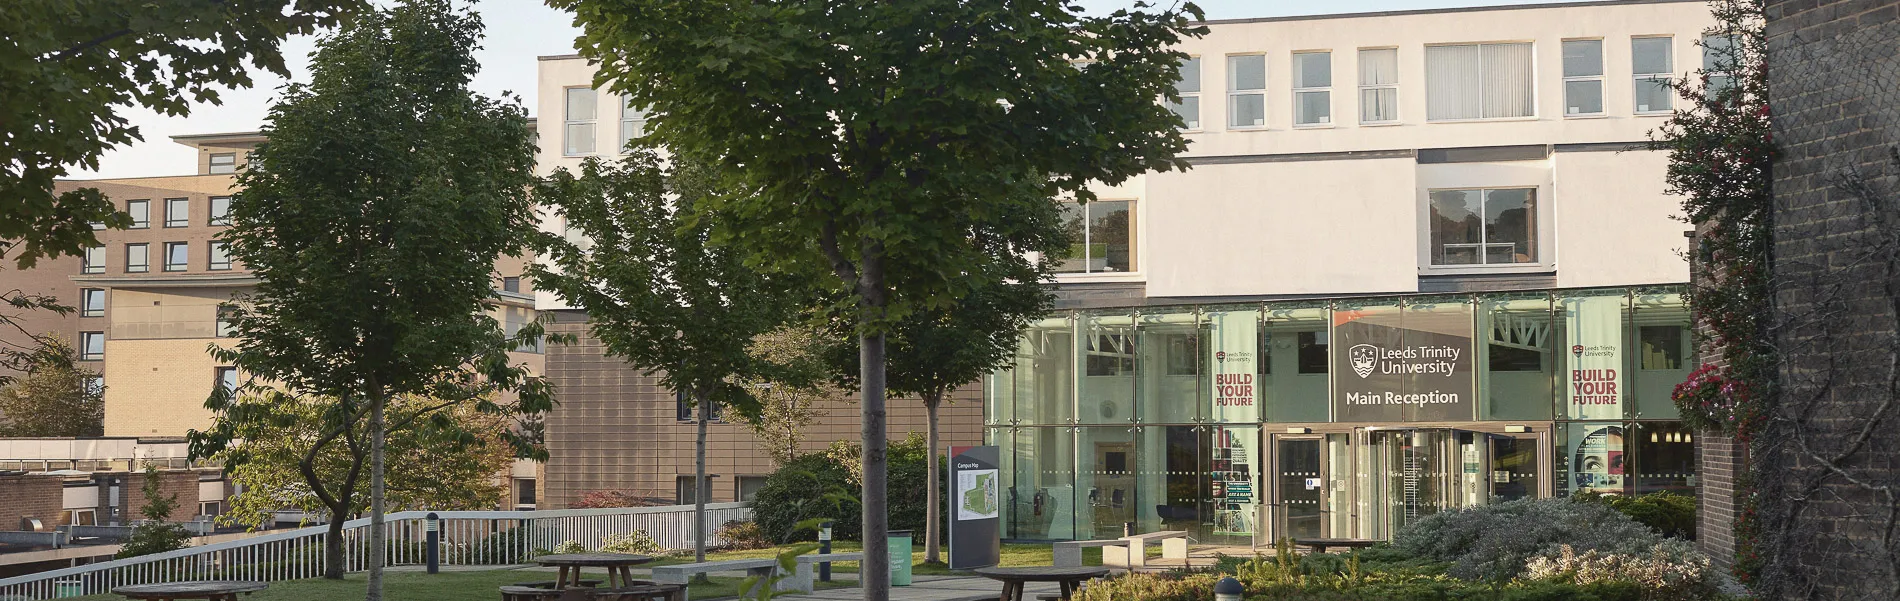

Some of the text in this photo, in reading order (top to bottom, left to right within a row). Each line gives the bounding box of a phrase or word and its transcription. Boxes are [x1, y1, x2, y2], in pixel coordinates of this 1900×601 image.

[1382, 346, 1460, 360] Leeds Trinity
[1382, 360, 1455, 376] University
[1216, 374, 1252, 384] BUILD
[1573, 369, 1616, 381] BUILD
[1216, 385, 1253, 397] YOUR
[1573, 382, 1617, 395] YOUR
[1216, 398, 1253, 406] FUTURE
[1346, 390, 1458, 407] Main Reception
[1573, 396, 1616, 405] FUTURE
